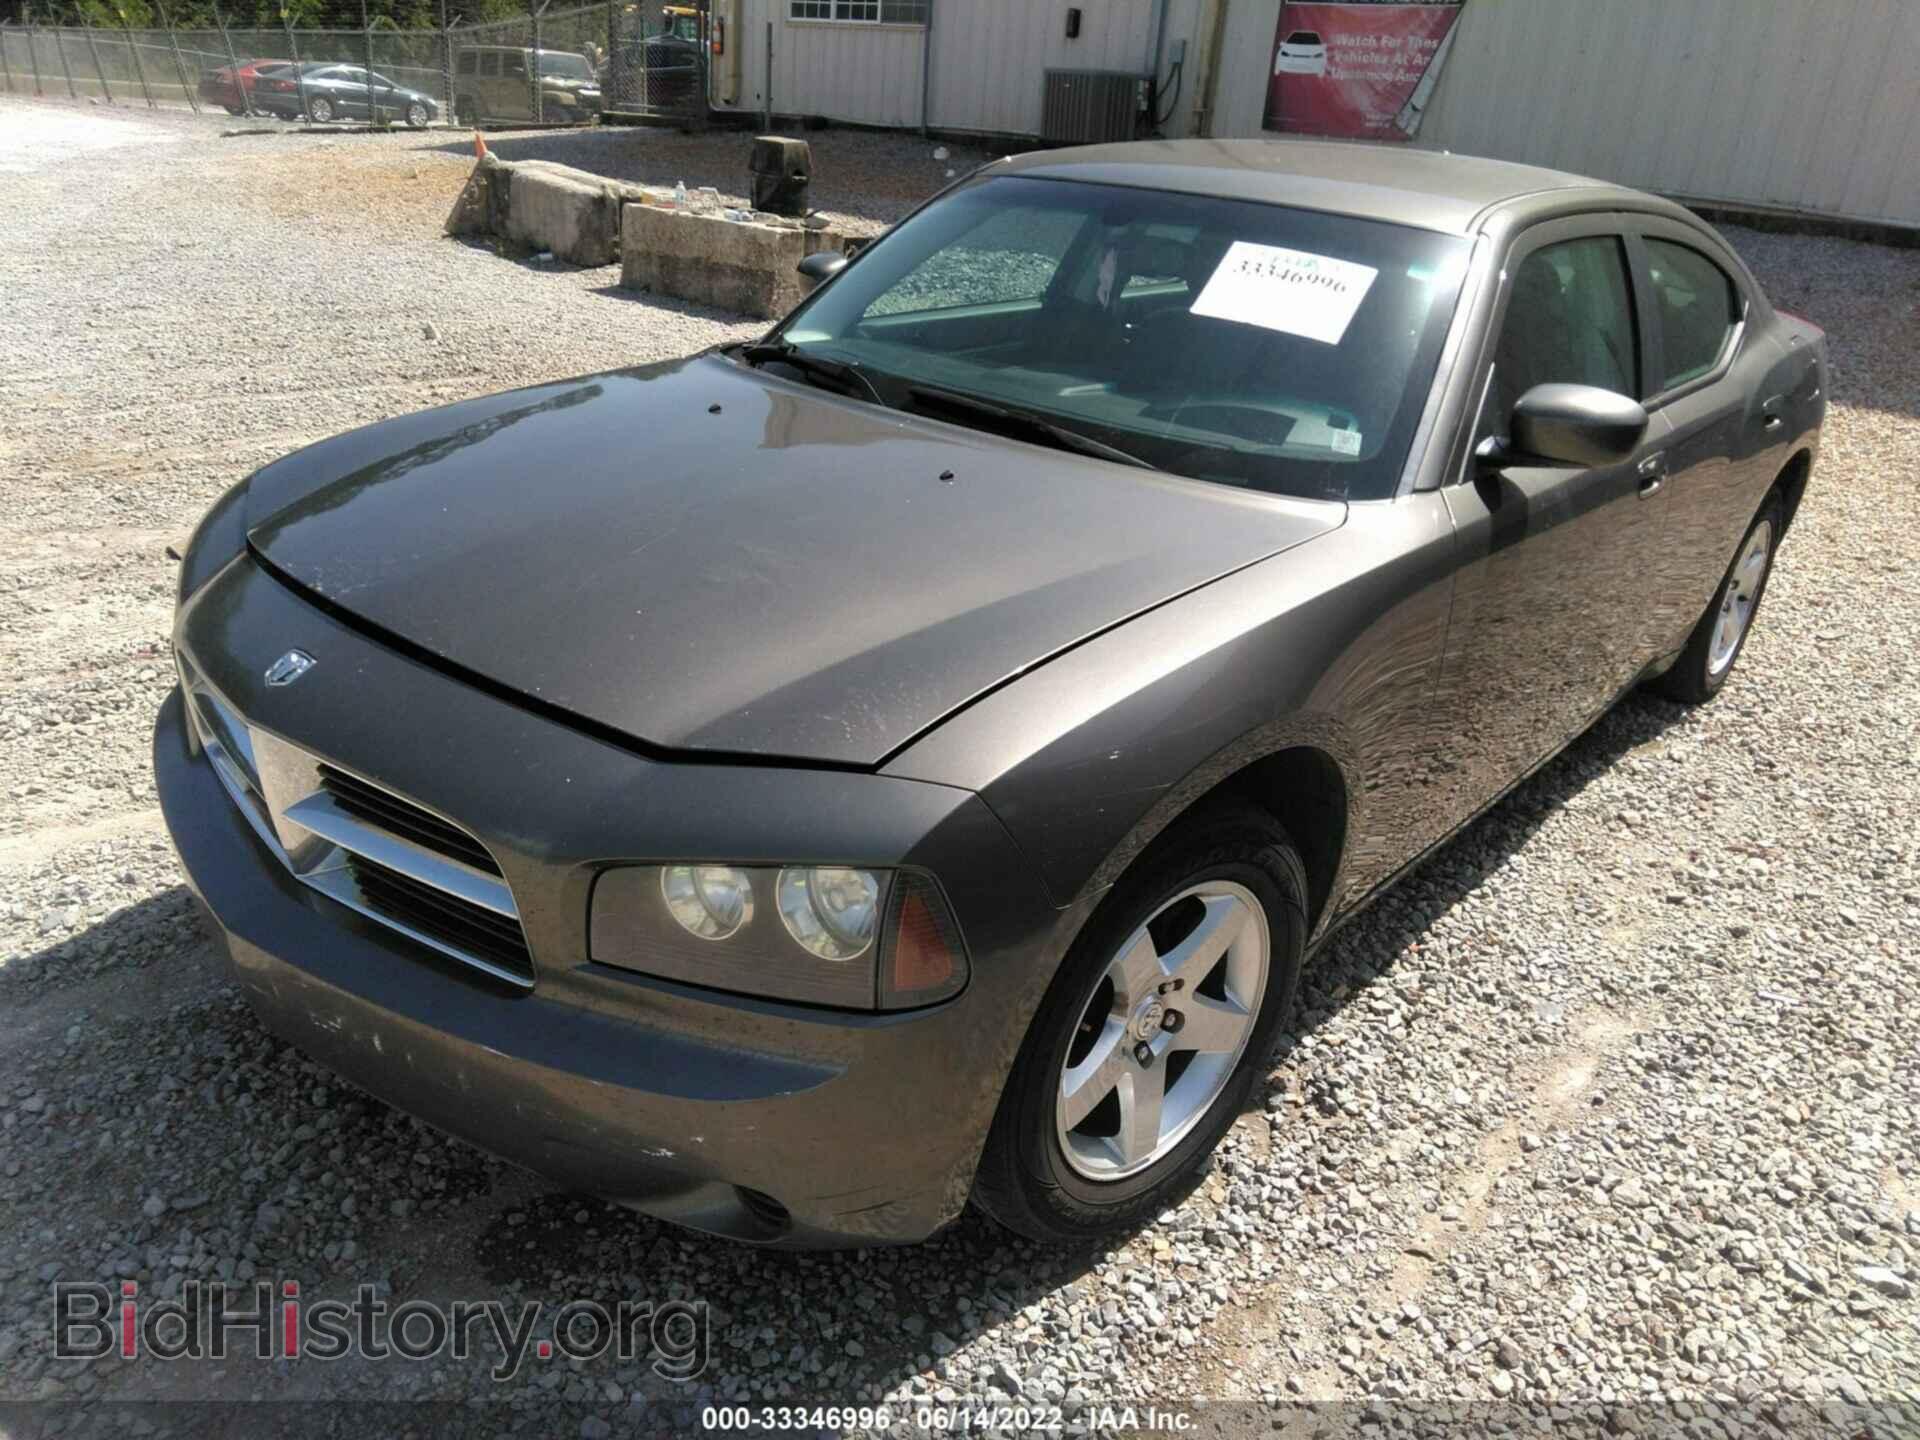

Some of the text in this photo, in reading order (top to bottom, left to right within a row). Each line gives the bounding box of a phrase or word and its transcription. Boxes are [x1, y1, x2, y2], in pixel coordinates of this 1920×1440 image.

[1335, 34, 1377, 48] Watch
[1381, 35, 1402, 48] For
[1333, 49, 1389, 65] Vehicles
[1392, 52, 1409, 65] At
